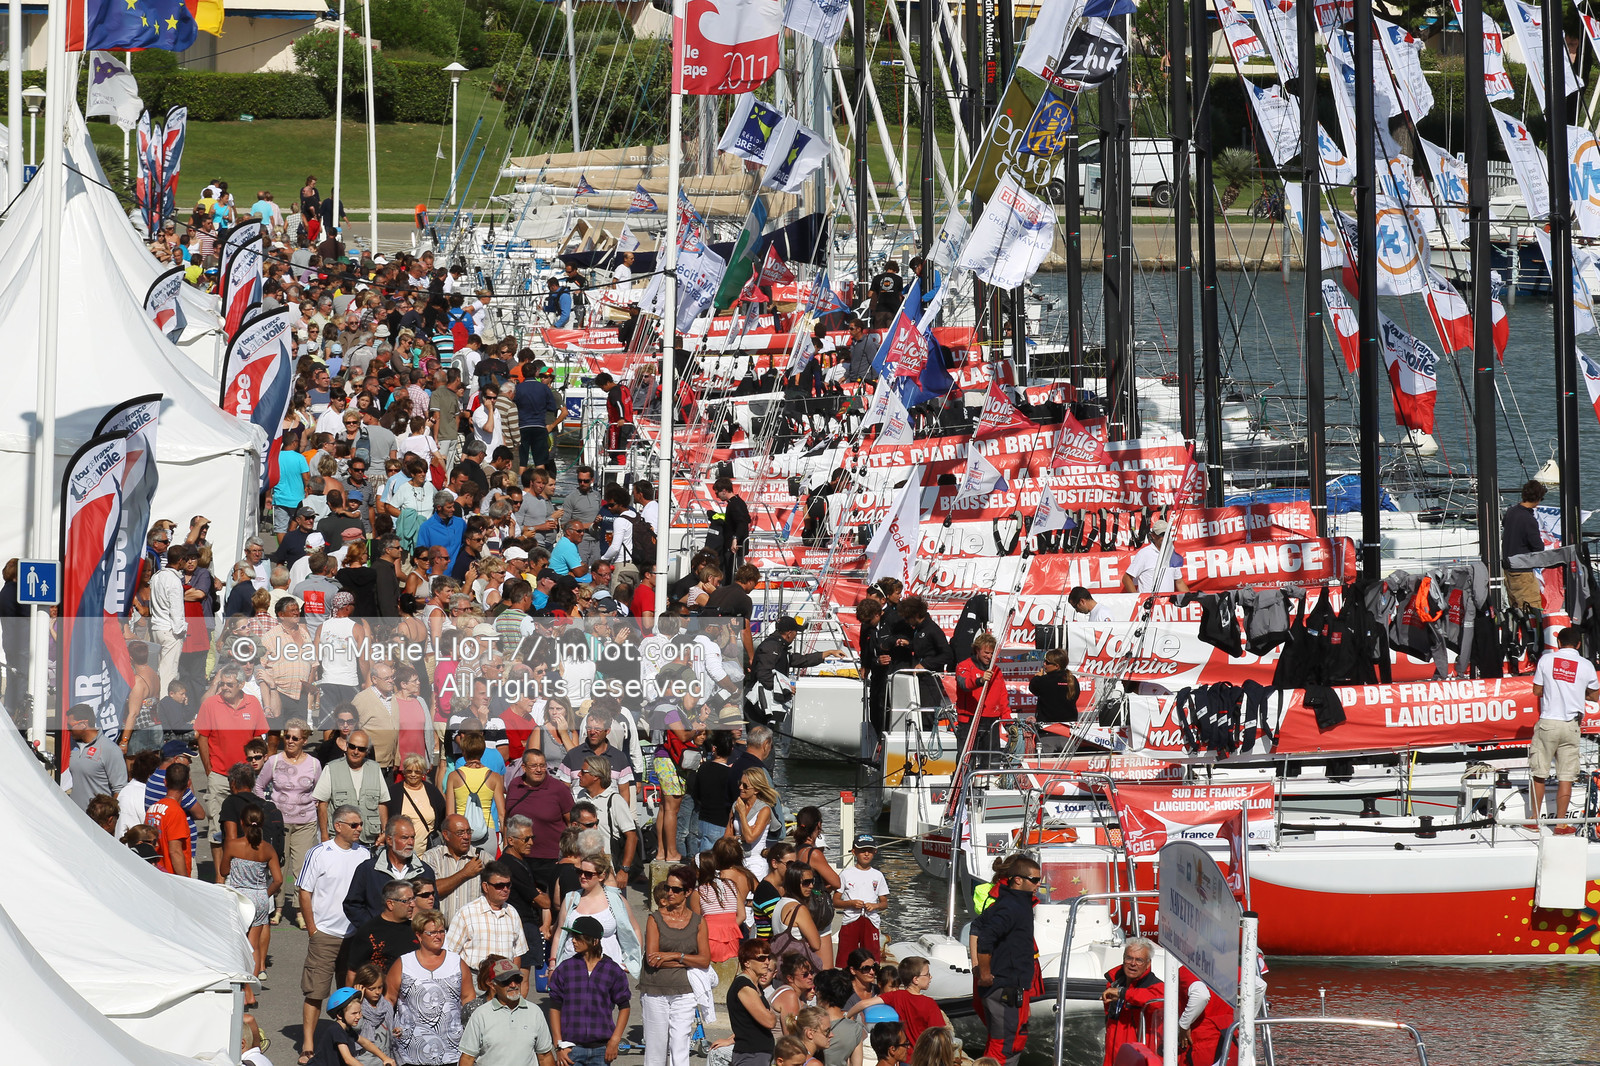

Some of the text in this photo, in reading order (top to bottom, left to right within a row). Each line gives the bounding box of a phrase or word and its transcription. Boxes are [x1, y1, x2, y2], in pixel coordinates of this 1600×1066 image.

[985, 0, 994, 13] dit
[986, 23, 995, 56] Mutuel
[1061, 42, 1122, 75] zhik
[718, 52, 768, 90] 2011
[676, 263, 698, 282] rédit
[242, 335, 255, 346] tour
[262, 316, 281, 331] france
[263, 321, 287, 342] voile
[1390, 324, 1404, 340] tour
[1405, 353, 1436, 376] voile
[985, 395, 1015, 415] Voile
[1029, 387, 1066, 405] PORT
[125, 404, 146, 422] france
[1062, 427, 1098, 452] Voile
[75, 465, 90, 481] tour
[94, 442, 115, 463] france
[96, 451, 120, 476] voile
[845, 450, 905, 468] CÔTES
[911, 438, 1000, 464] D'ARMOR
[1014, 478, 1035, 488] DE
[1038, 474, 1120, 488] BRUXELLES
[941, 492, 1016, 511] BRUSSELS
[1182, 514, 1311, 540] MÉDITERRANÉE
[1069, 557, 1121, 589] ILE
[1085, 626, 1181, 659] Voile
[1083, 658, 1178, 675] magazine
[1364, 686, 1394, 705] DE
[1401, 679, 1486, 702] FRANCE
[1493, 679, 1501, 697] /
[1385, 700, 1518, 728] LANGUEDOC
[1087, 759, 1106, 770] SUD
[1111, 758, 1122, 768] DE
[1123, 758, 1161, 768] FRANCE
[1171, 786, 1255, 799] SUD DE FRANCE /
[1064, 804, 1087, 812] tour
[1181, 831, 1214, 839] france
[1256, 830, 1271, 839] 2011
